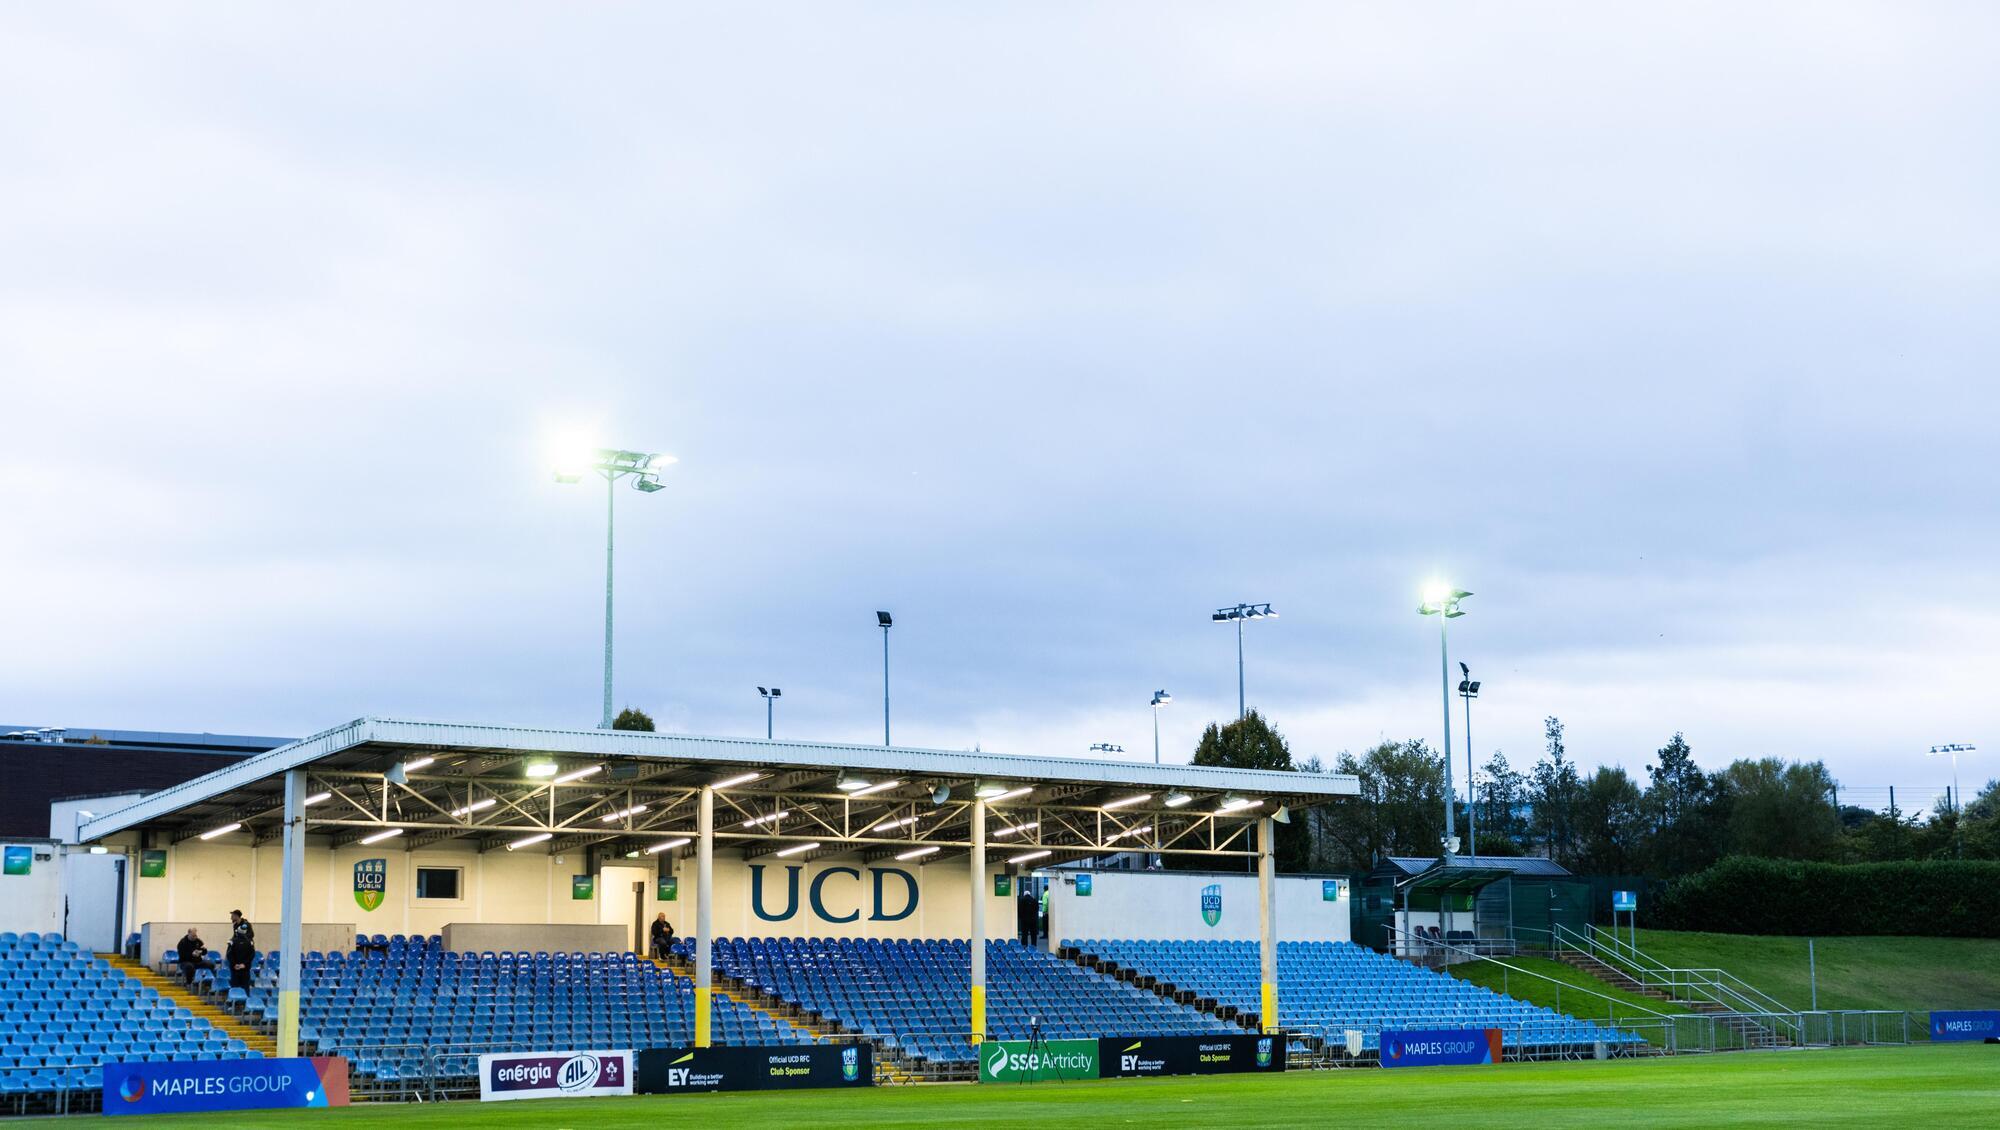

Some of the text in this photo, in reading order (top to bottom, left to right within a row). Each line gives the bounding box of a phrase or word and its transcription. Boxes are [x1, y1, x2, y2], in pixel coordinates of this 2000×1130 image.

[357, 873, 383, 884] UCD
[748, 864, 919, 924] UCD
[1203, 896, 1220, 905] UCD
[1946, 1020, 1994, 1031] MAPLES GROUP
[1405, 1041, 1475, 1055] MAPLES GROUP
[769, 1055, 810, 1063] Official UCD RFC
[1041, 1052, 1093, 1072] Airtricity
[1121, 1055, 1138, 1071] EY
[1200, 1054, 1230, 1062] Club Sponsor
[566, 1060, 588, 1084] AIL
[669, 1068, 690, 1086] EY
[770, 1067, 810, 1077] Club Sponsor
[152, 1075, 292, 1096] MAPLES GROUP
